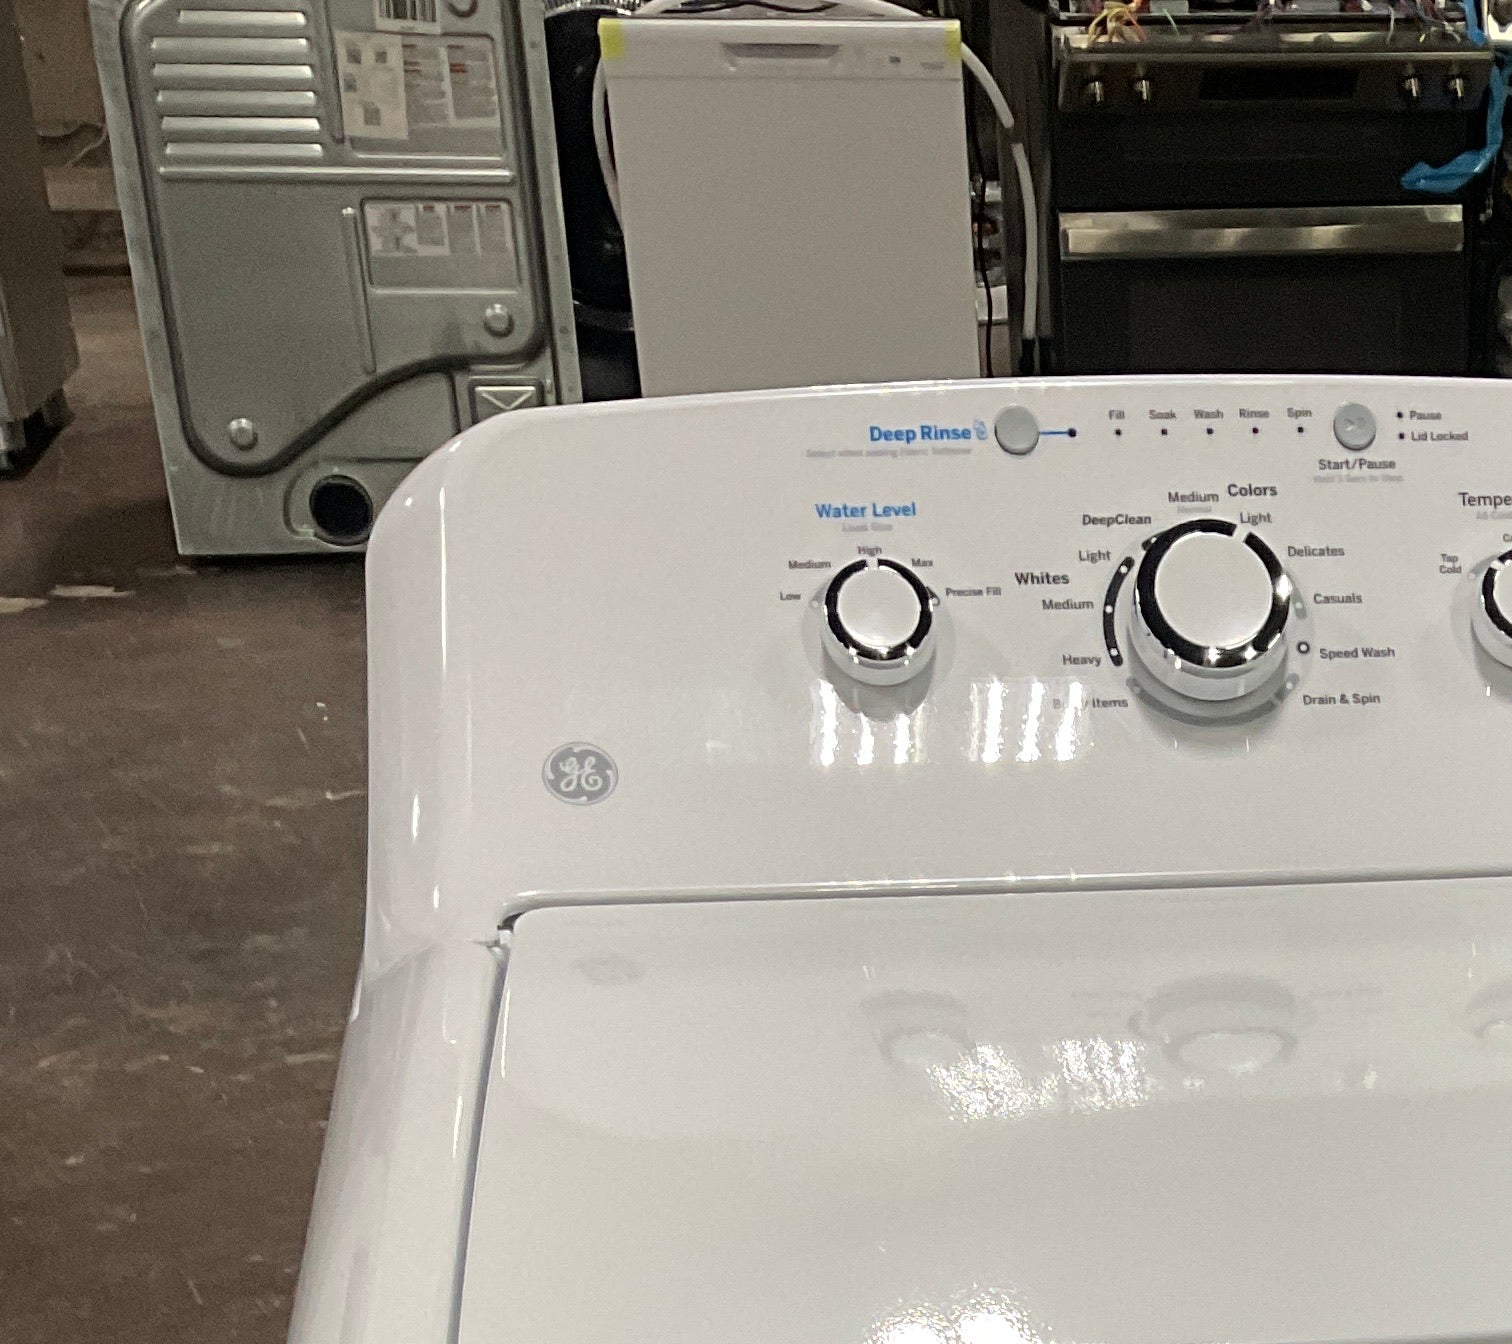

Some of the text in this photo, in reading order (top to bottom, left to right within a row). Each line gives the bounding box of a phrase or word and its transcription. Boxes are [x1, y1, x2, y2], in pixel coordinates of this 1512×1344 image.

[1108, 409, 1125, 420] Fill
[1149, 409, 1177, 420] Soak
[1194, 409, 1224, 420] Wash
[1239, 408, 1269, 419] Rinse
[1287, 407, 1312, 420] Spin
[1409, 410, 1442, 420] Pause
[869, 424, 972, 444] Deep Rinse
[1410, 431, 1469, 442] Lid Locked
[1318, 458, 1396, 471] Start/Pause
[1227, 484, 1278, 497] Colors
[1168, 491, 1219, 503] Medium
[815, 502, 917, 518] Water Level
[1082, 513, 1152, 527] DeepClean
[1240, 513, 1272, 525] Light
[857, 546, 882, 557] High
[1078, 550, 1111, 564] Light
[1288, 546, 1345, 557] Delicates
[788, 560, 831, 570] Medium
[1015, 571, 1070, 586] Whites
[1042, 598, 1094, 610] Medium
[1313, 592, 1362, 604] Casuals
[1062, 653, 1101, 666] Heavy
[1319, 647, 1395, 661] Speed Wash
[1092, 699, 1128, 709] Items
[1302, 693, 1381, 706] Drain & Spin
